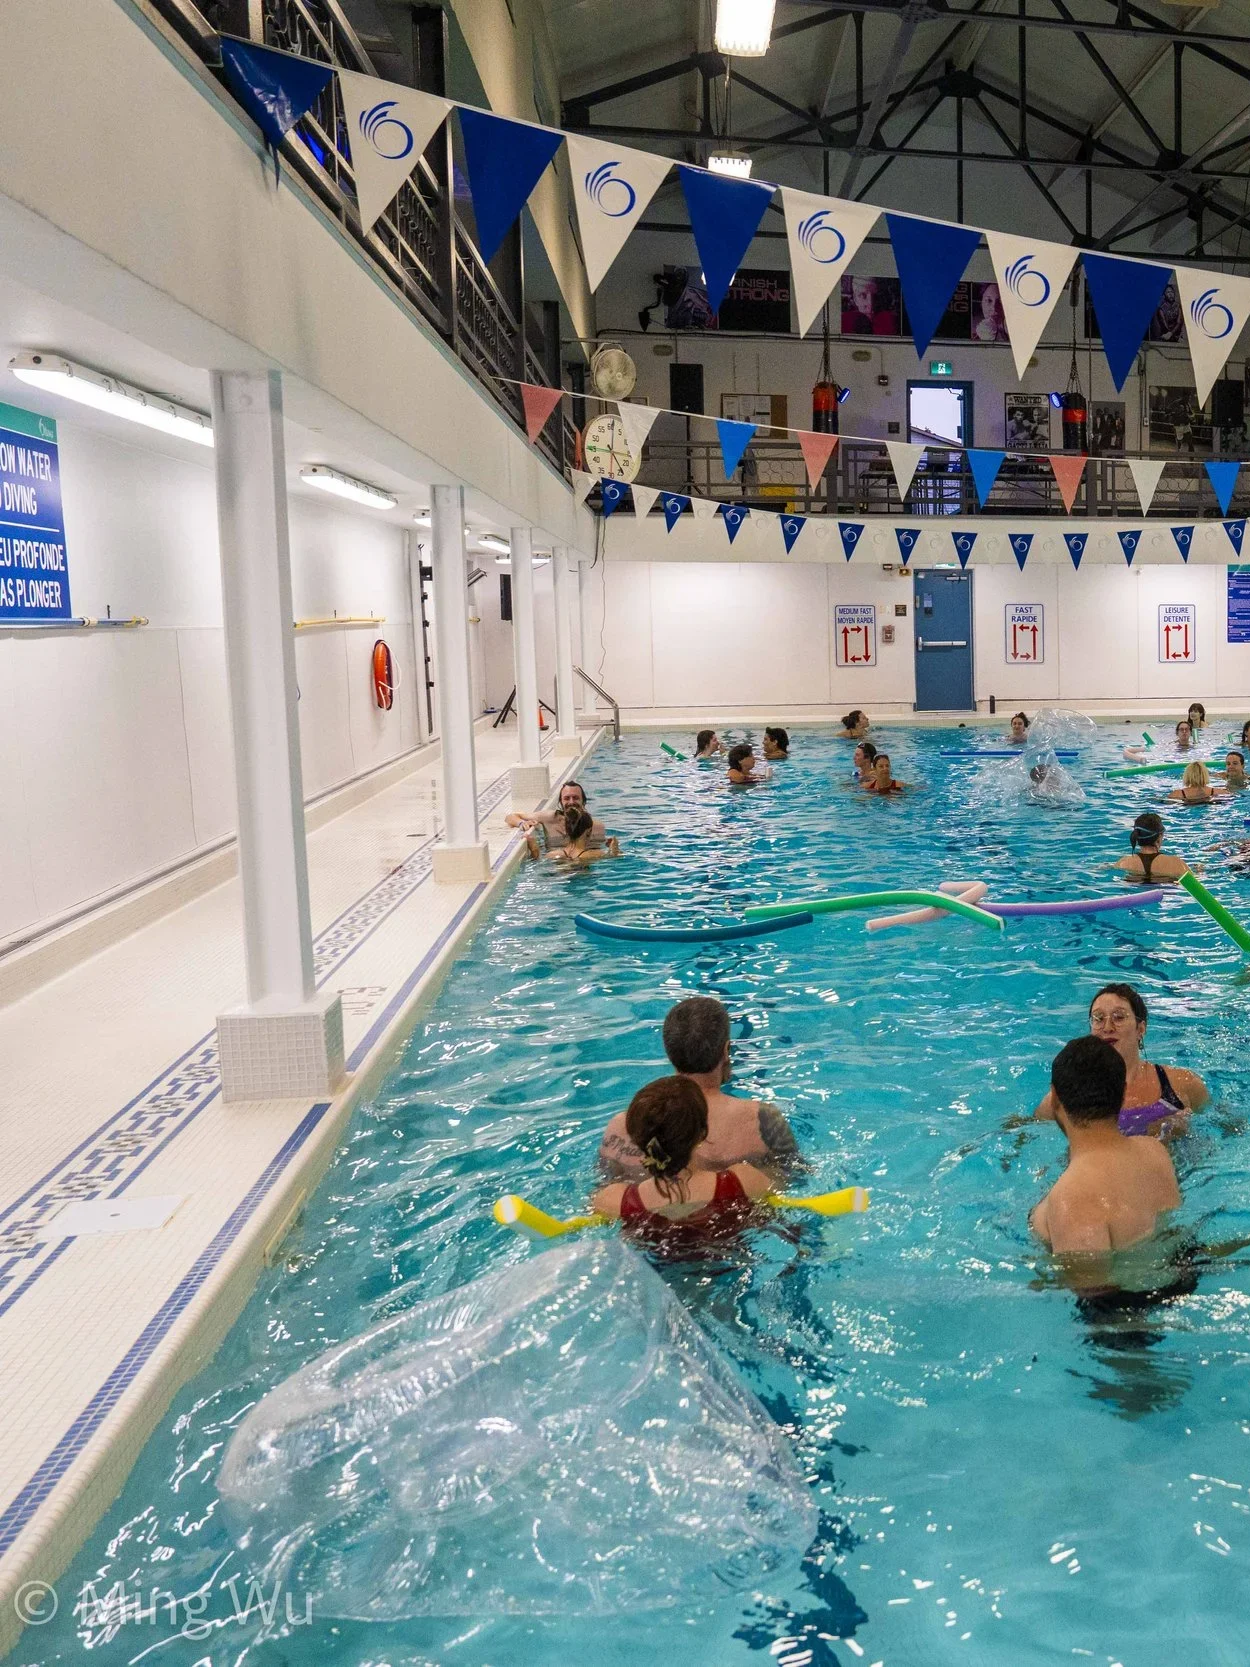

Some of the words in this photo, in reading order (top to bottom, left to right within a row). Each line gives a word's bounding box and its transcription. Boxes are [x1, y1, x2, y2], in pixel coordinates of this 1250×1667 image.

[1013, 396, 1042, 404] WANTED
[0, 442, 16, 474] OW
[17, 447, 52, 481] WATER
[3, 482, 37, 515] DIVING
[13, 539, 65, 571] PROFONDE
[16, 578, 62, 609] PLONGER
[838, 607, 859, 615] MEDIUM
[860, 607, 872, 615] FAST
[1015, 606, 1033, 614] FAST
[1165, 606, 1189, 614] LEISURE
[837, 616, 856, 624] MOYEN
[856, 616, 874, 624] RAPIDE
[1011, 615, 1038, 623] RAPIDE
[1163, 615, 1191, 623] DETENTE
